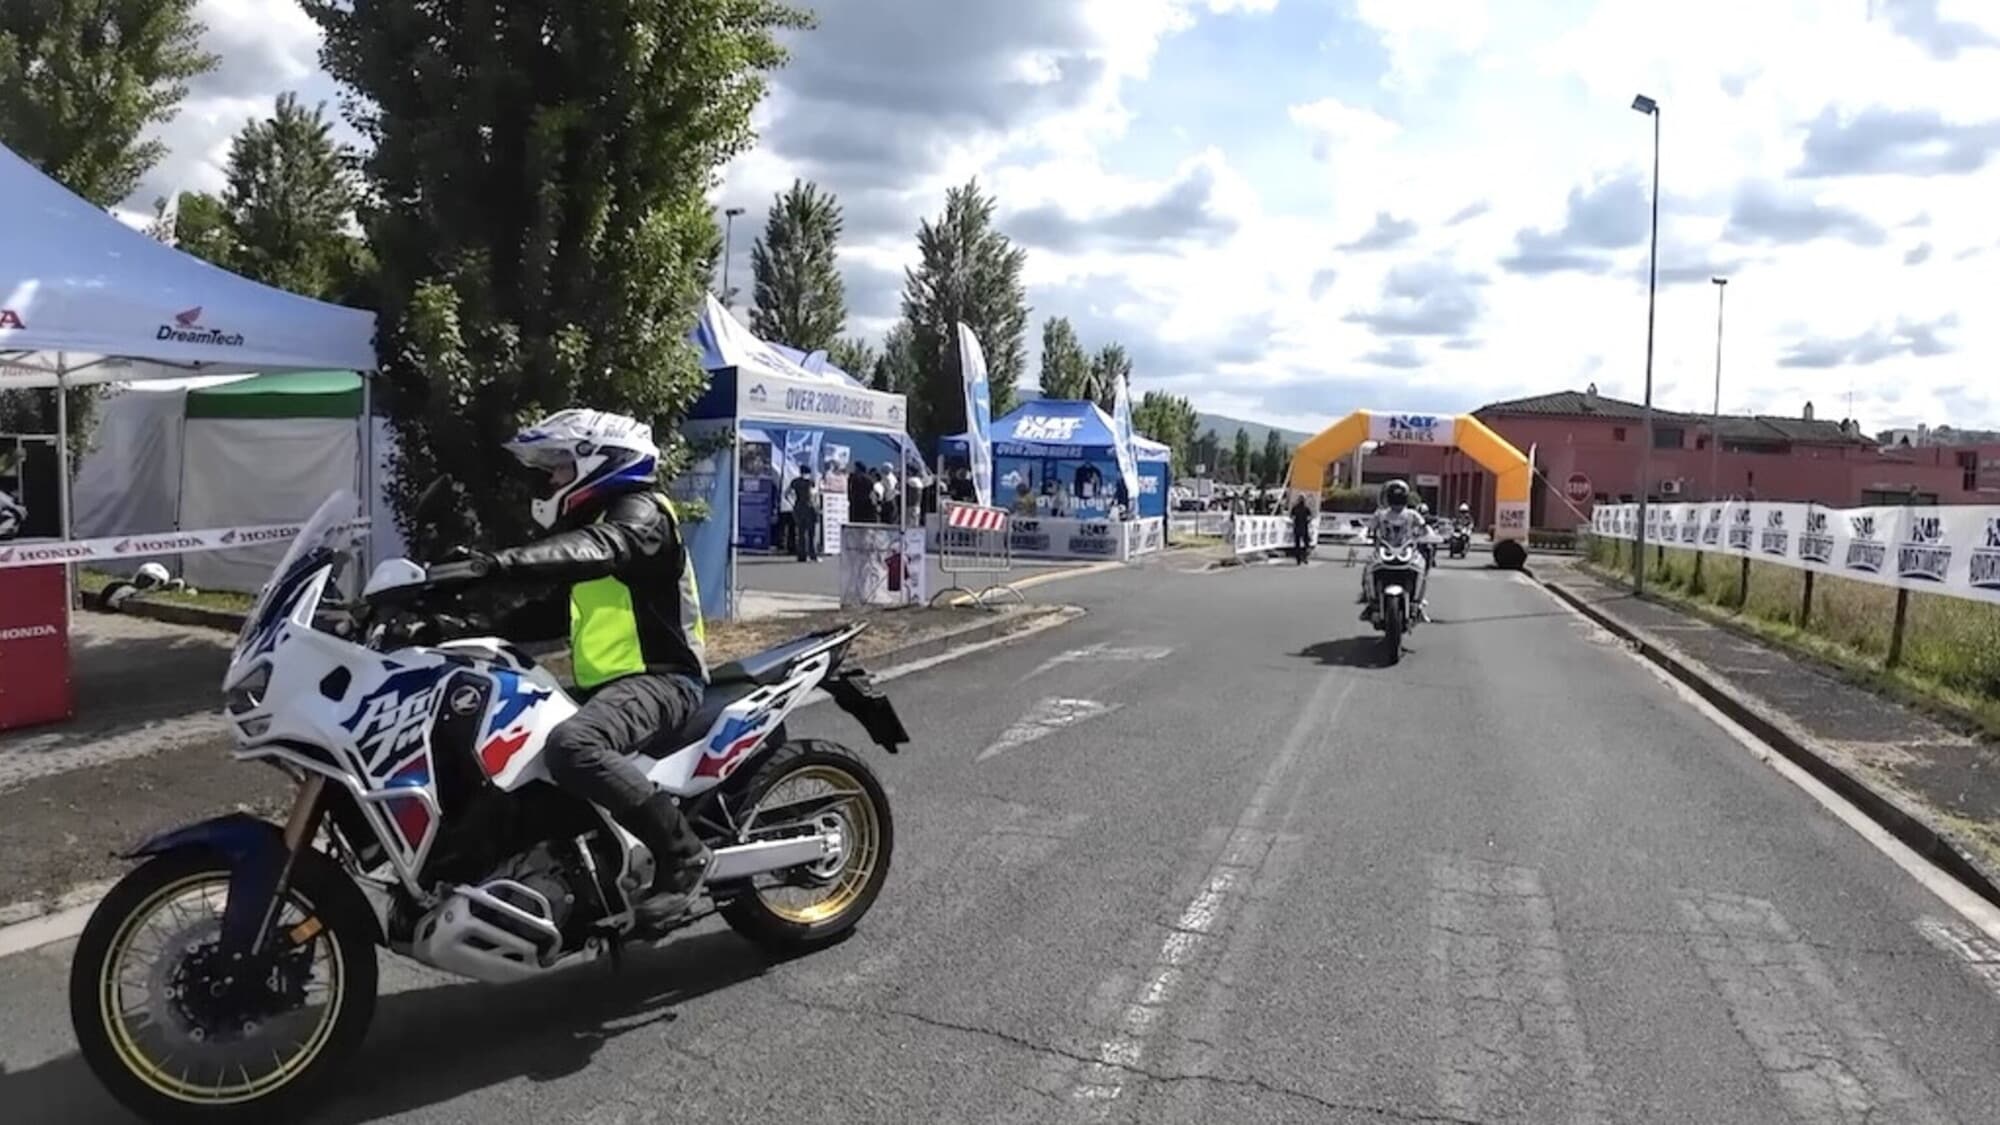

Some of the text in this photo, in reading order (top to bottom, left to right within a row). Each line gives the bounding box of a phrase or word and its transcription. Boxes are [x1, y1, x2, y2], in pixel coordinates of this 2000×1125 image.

[156, 325, 244, 346] DreamTech
[786, 387, 874, 419] OVER 2000 RIDERS
[1388, 430, 1434, 442] SERIES
[1568, 482, 1588, 494] STOP
[240, 527, 301, 542] HONDA
[134, 537, 204, 551] HONDA
[19, 547, 95, 561] HONDA
